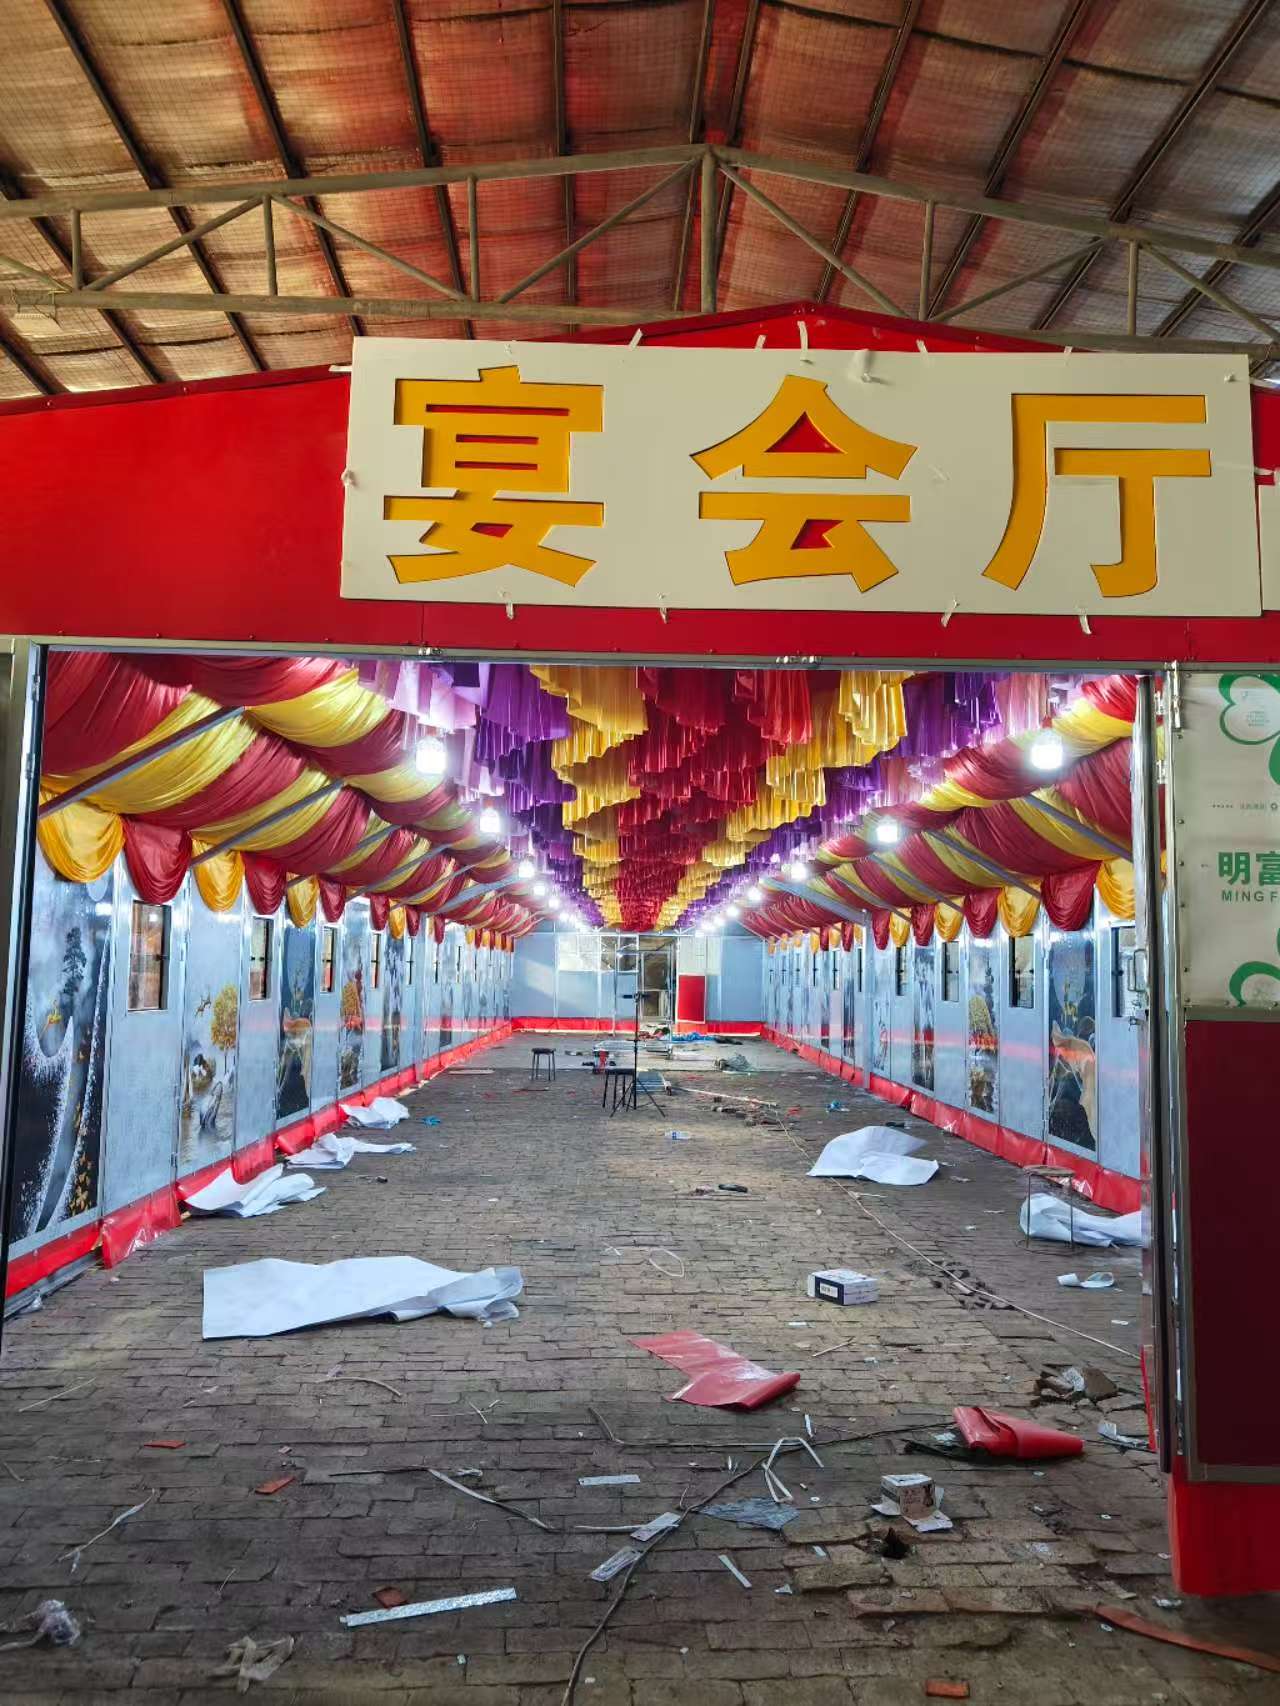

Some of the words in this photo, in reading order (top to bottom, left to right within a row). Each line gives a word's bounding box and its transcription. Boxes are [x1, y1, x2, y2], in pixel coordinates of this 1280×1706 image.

[384, 366, 1212, 598] 宴会厅
[1222, 890, 1264, 902] MING
